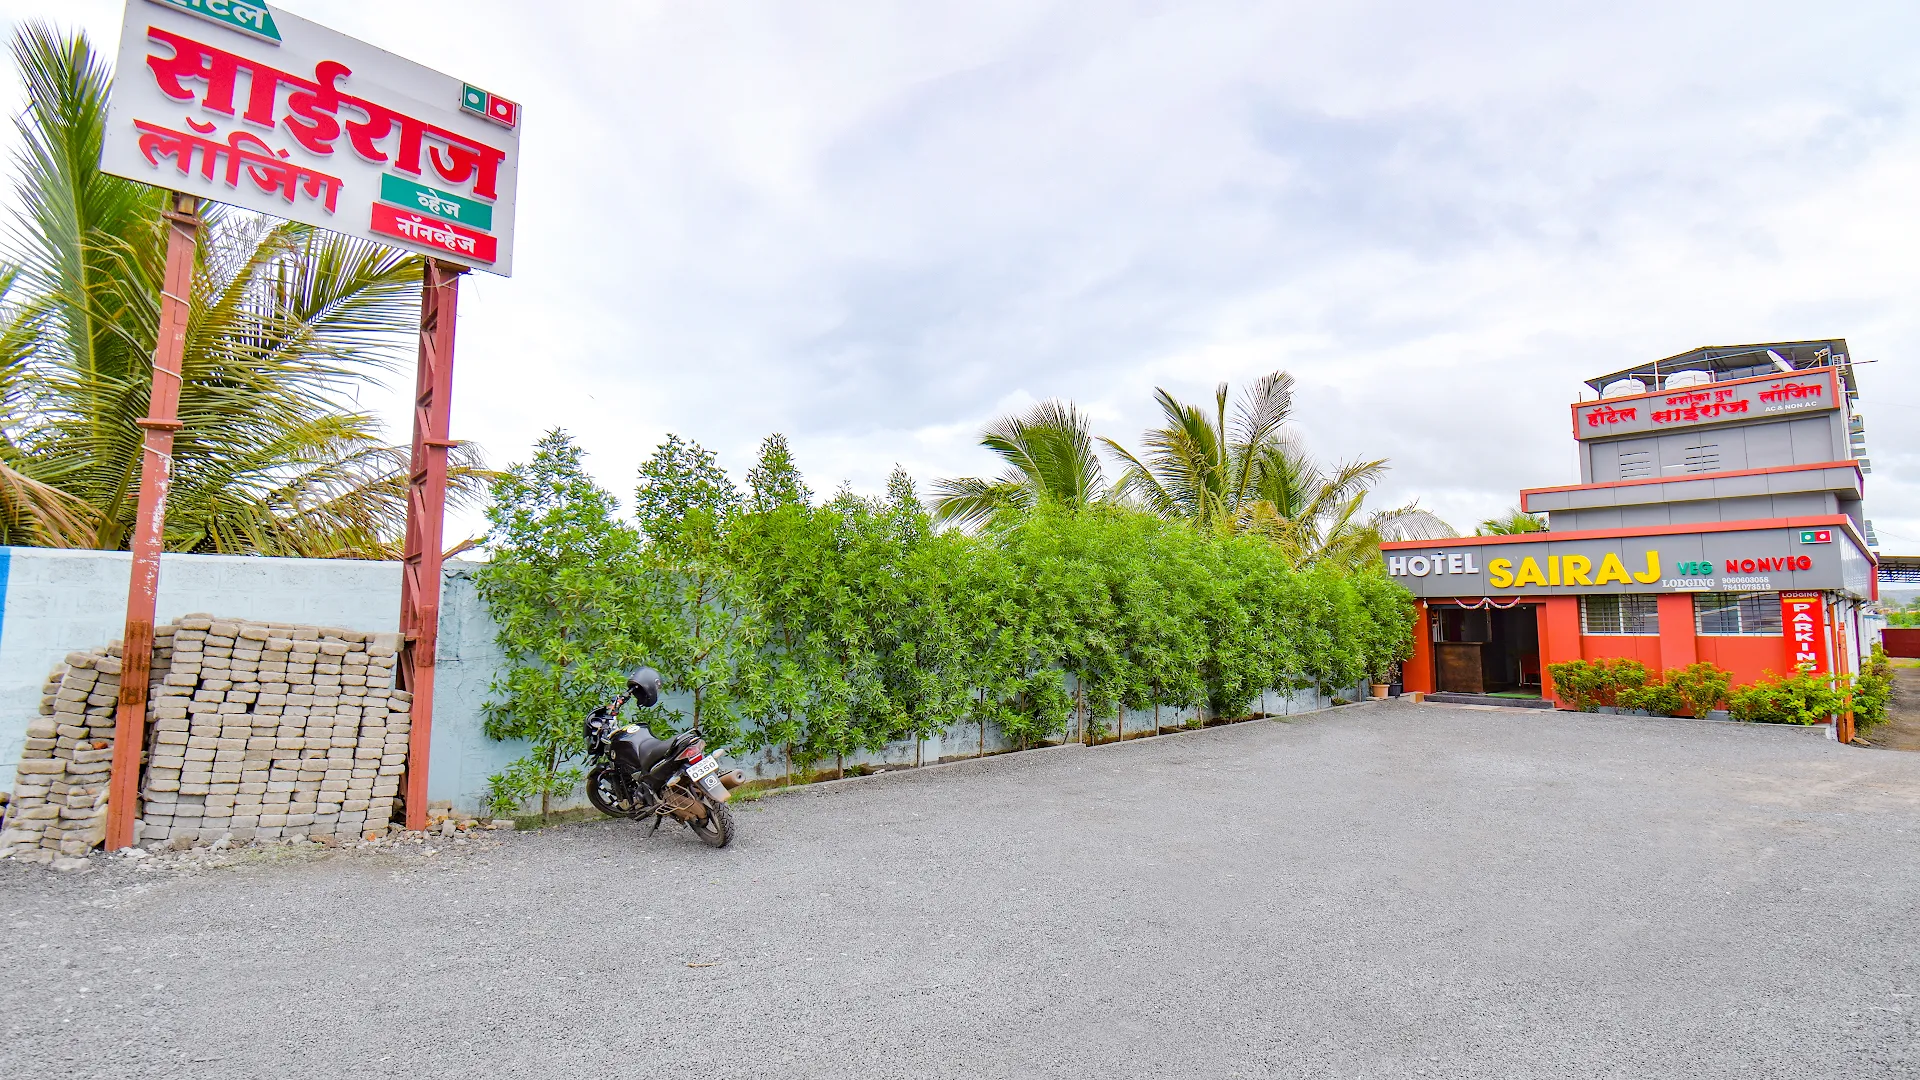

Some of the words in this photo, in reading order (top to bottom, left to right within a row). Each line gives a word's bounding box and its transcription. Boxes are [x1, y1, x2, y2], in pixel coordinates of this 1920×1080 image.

[146, 25, 505, 201] साईराज
[133, 116, 343, 216] लॉजिंग
[415, 188, 461, 218] व्हेज
[395, 214, 476, 254] नॉनव्हेज
[1757, 382, 1823, 404] लॉजिंग
[1586, 405, 1637, 427] हॉटेल
[1651, 399, 1750, 423] साईराज
[1389, 553, 1479, 577] HOTEL
[1488, 550, 1661, 588] SAIRAJ
[1677, 561, 1713, 575] VEG
[1725, 555, 1812, 574] NONVEG
[1662, 578, 1715, 588] LODGING
[692, 760, 716, 779] 0350
